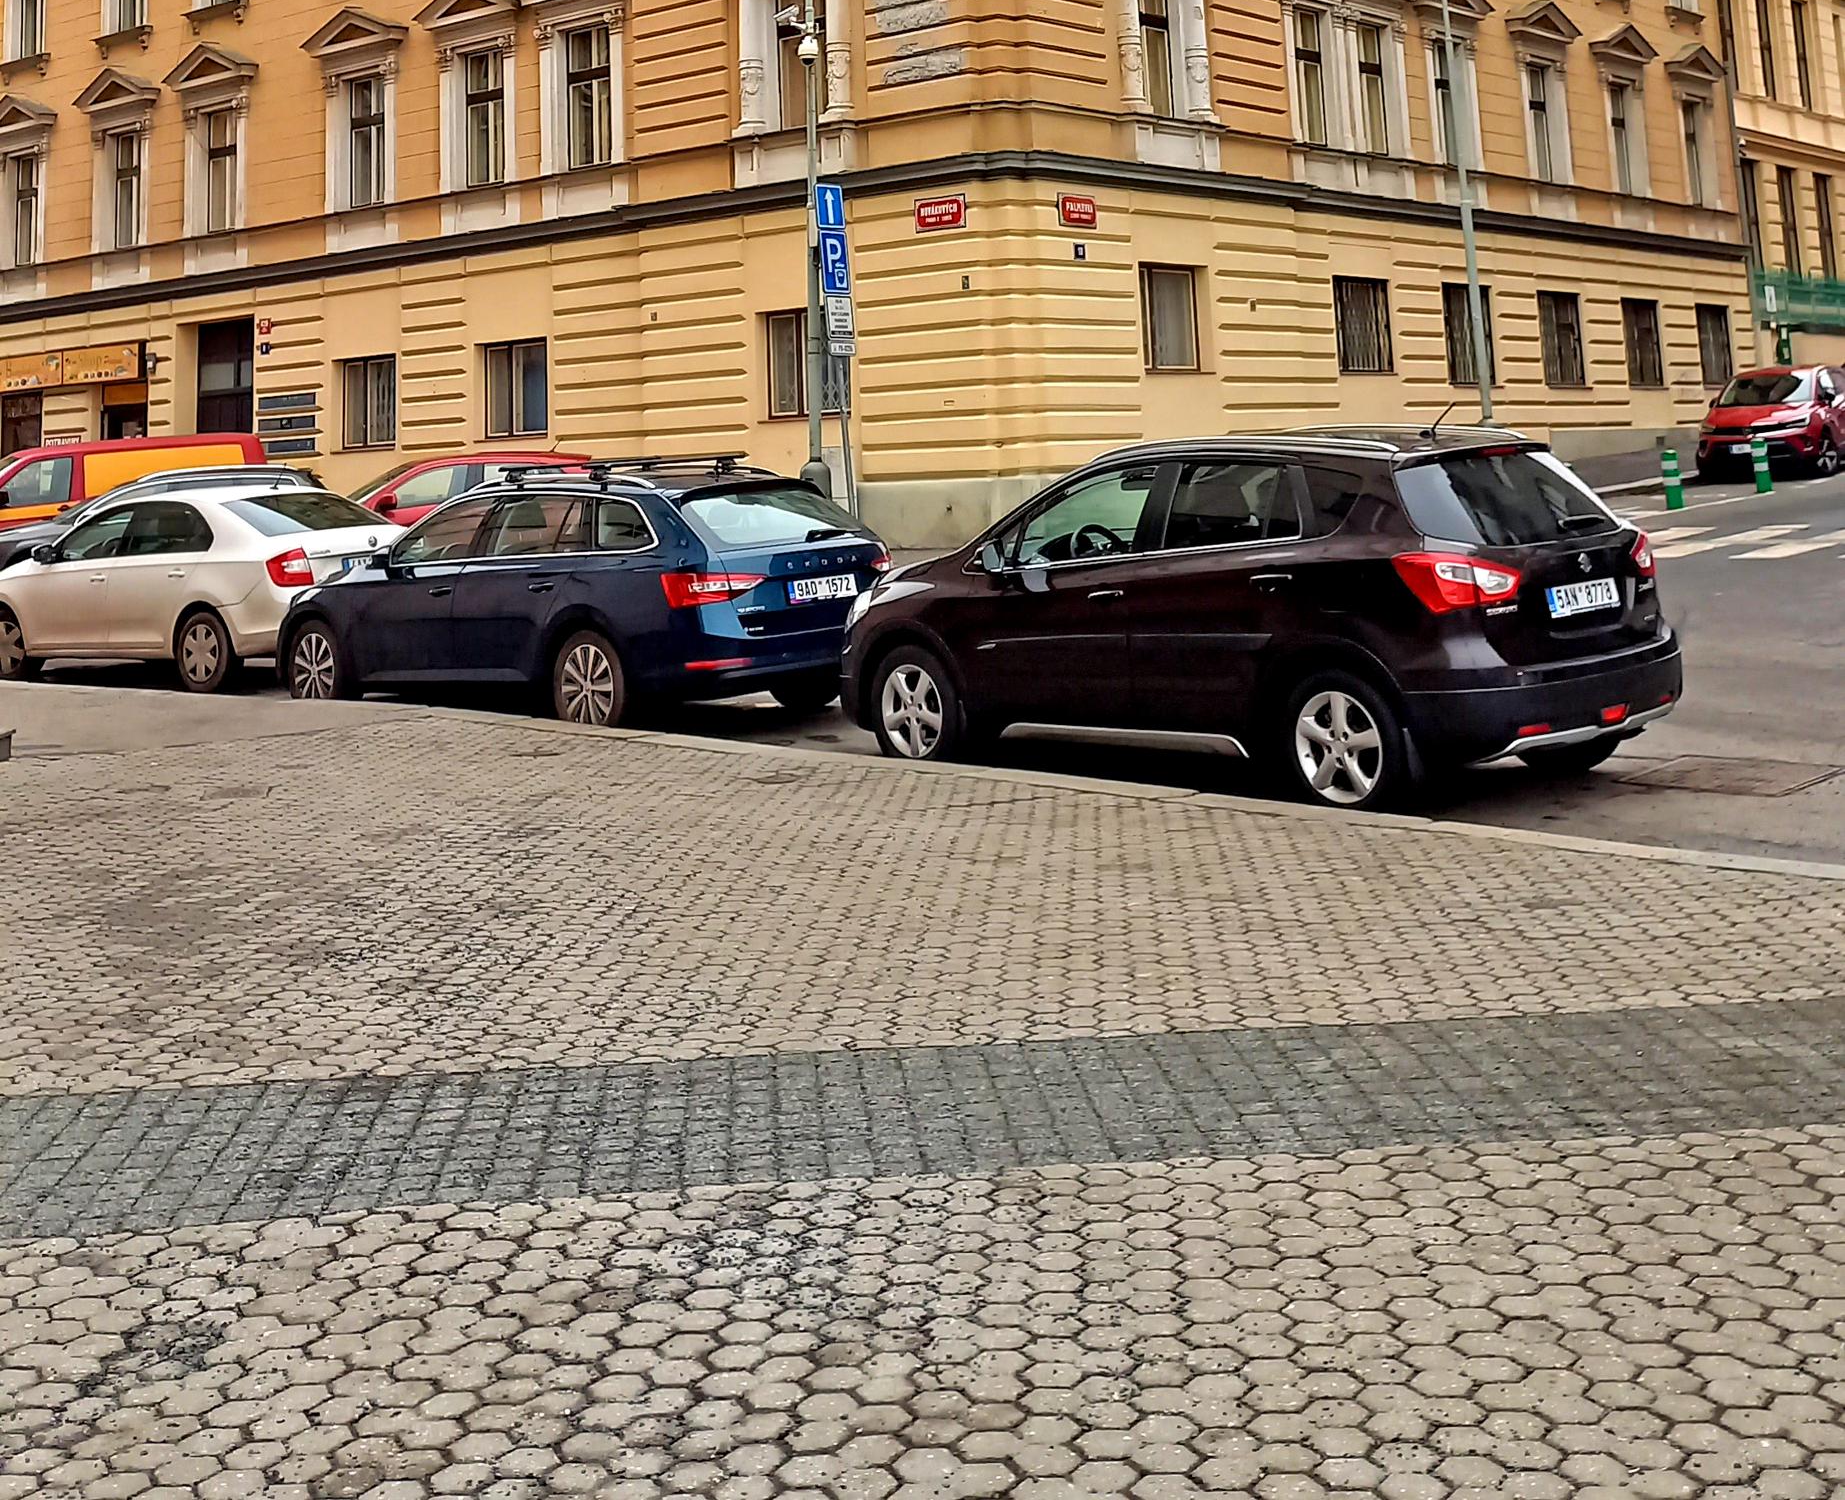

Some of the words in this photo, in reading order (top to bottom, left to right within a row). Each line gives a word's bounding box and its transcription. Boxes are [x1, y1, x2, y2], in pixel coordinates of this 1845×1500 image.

[825, 237, 842, 273] P
[797, 581, 818, 597] 9AD
[825, 577, 852, 594] 1572
[1556, 587, 1580, 609] 5AN
[1585, 581, 1613, 604] 8778
